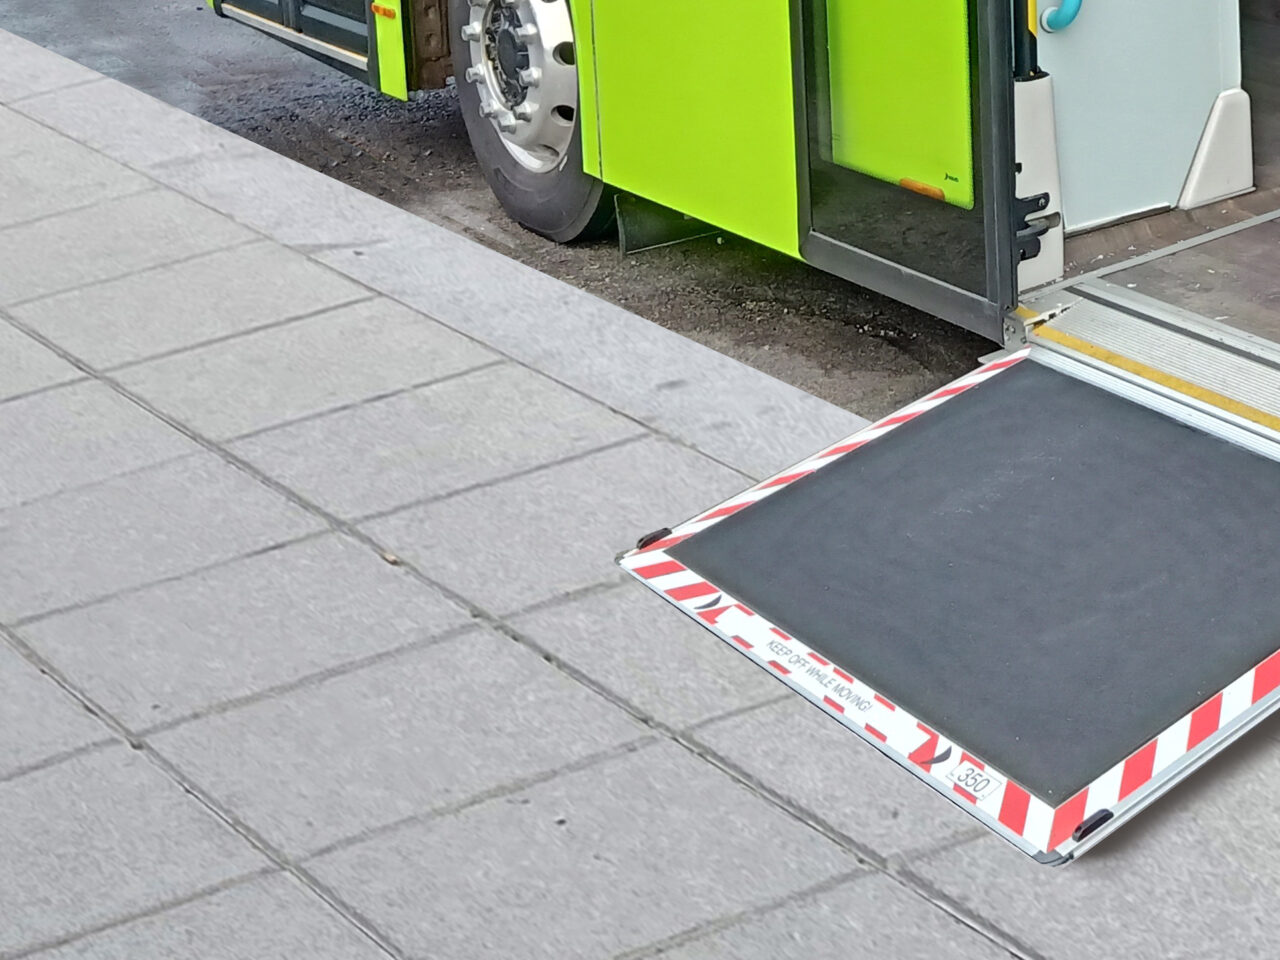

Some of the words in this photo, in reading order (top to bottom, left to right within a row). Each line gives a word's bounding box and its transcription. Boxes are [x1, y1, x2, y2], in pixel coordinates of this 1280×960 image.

[766, 639, 793, 657] KEEP
[787, 653, 811, 669] OFF
[805, 665, 837, 688] WHILE
[831, 683, 873, 713] MOVING!
[957, 767, 991, 793] 350
